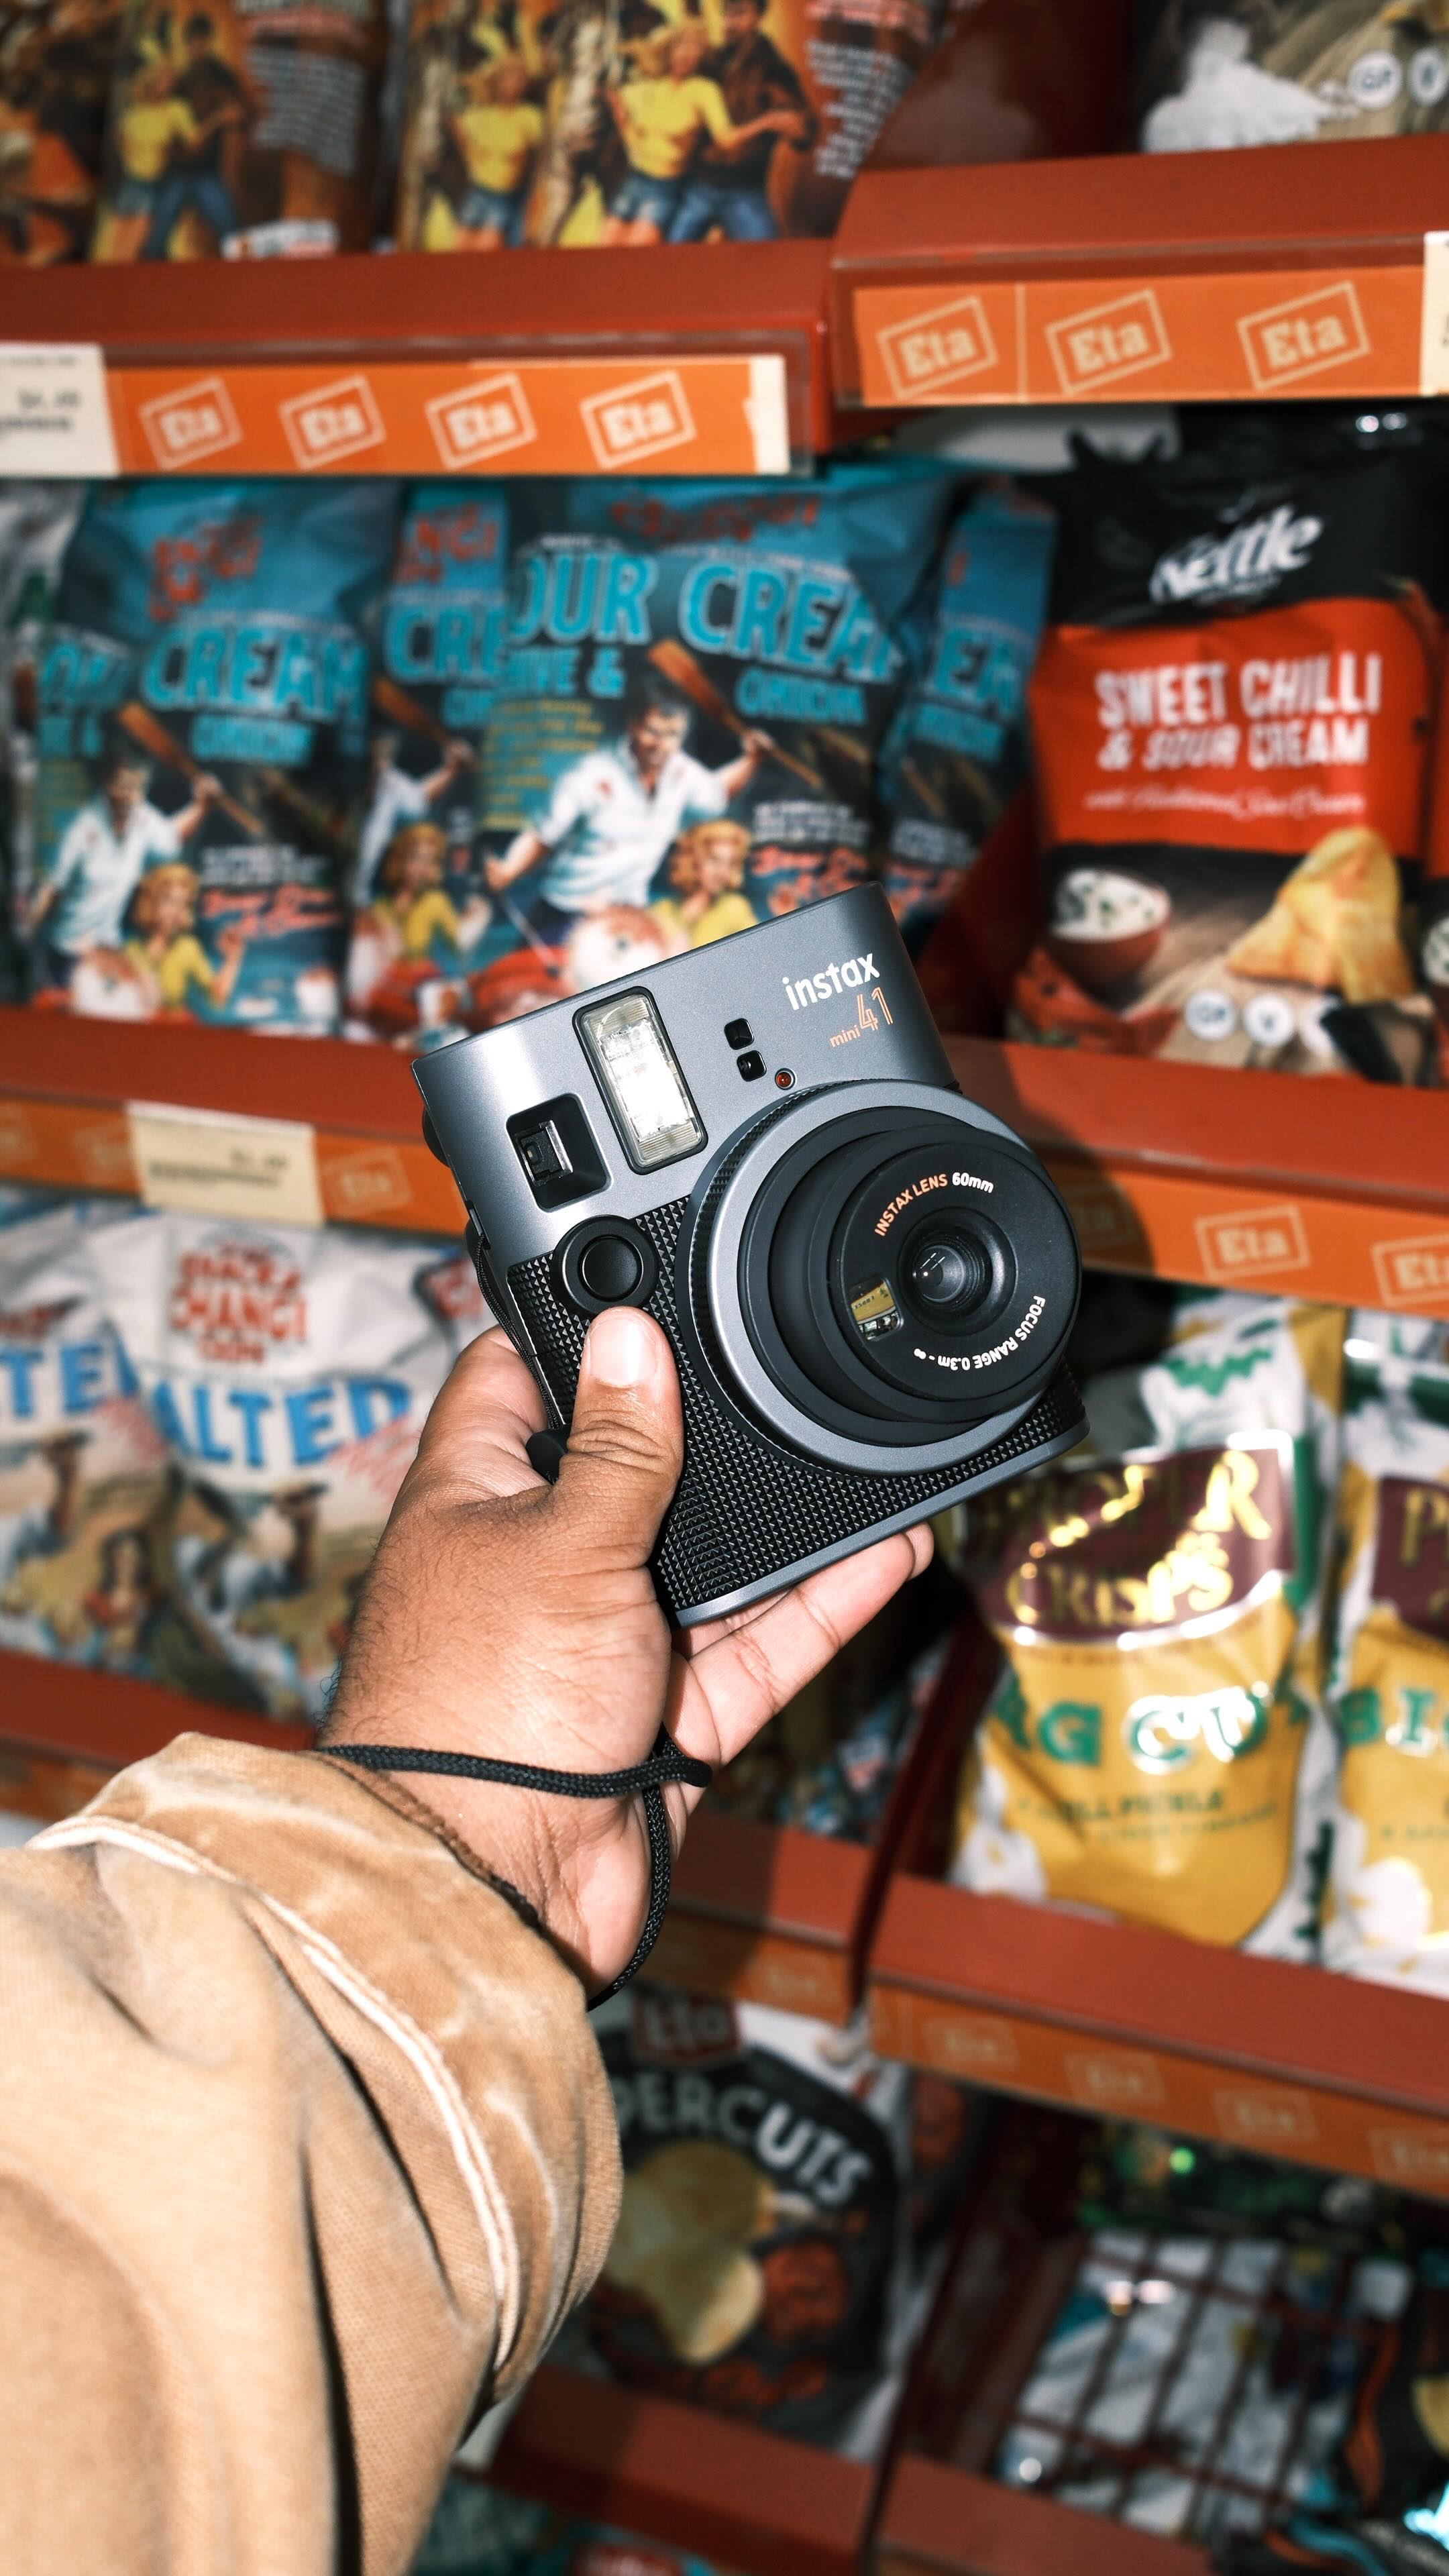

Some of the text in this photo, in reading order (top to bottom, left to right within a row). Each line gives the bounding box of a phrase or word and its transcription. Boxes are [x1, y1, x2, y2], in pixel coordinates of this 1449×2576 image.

[898, 329, 977, 378] Eta
[1067, 322, 1149, 374] Eta
[1260, 315, 1347, 370] Eta
[445, 403, 515, 450] Eta
[601, 403, 676, 449] Eta
[508, 550, 659, 645] OUR
[382, 600, 511, 683] CRE
[1096, 663, 1226, 727] SWEET
[1241, 652, 1382, 718] CHILLI
[1097, 718, 1368, 770] & SOUR CREAM
[782, 953, 880, 1011] instax
[829, 987, 894, 1047] mini 41
[874, 1172, 994, 1236] INSTAX LENS 60mm
[1215, 1228, 1289, 1265] Eta
[1015, 1295, 1046, 1342] FOCUS
[938, 1355, 971, 1371] 0.3m
[973, 1336, 1019, 1370] RANGE
[612, 2072, 871, 2207] PERCUTS
